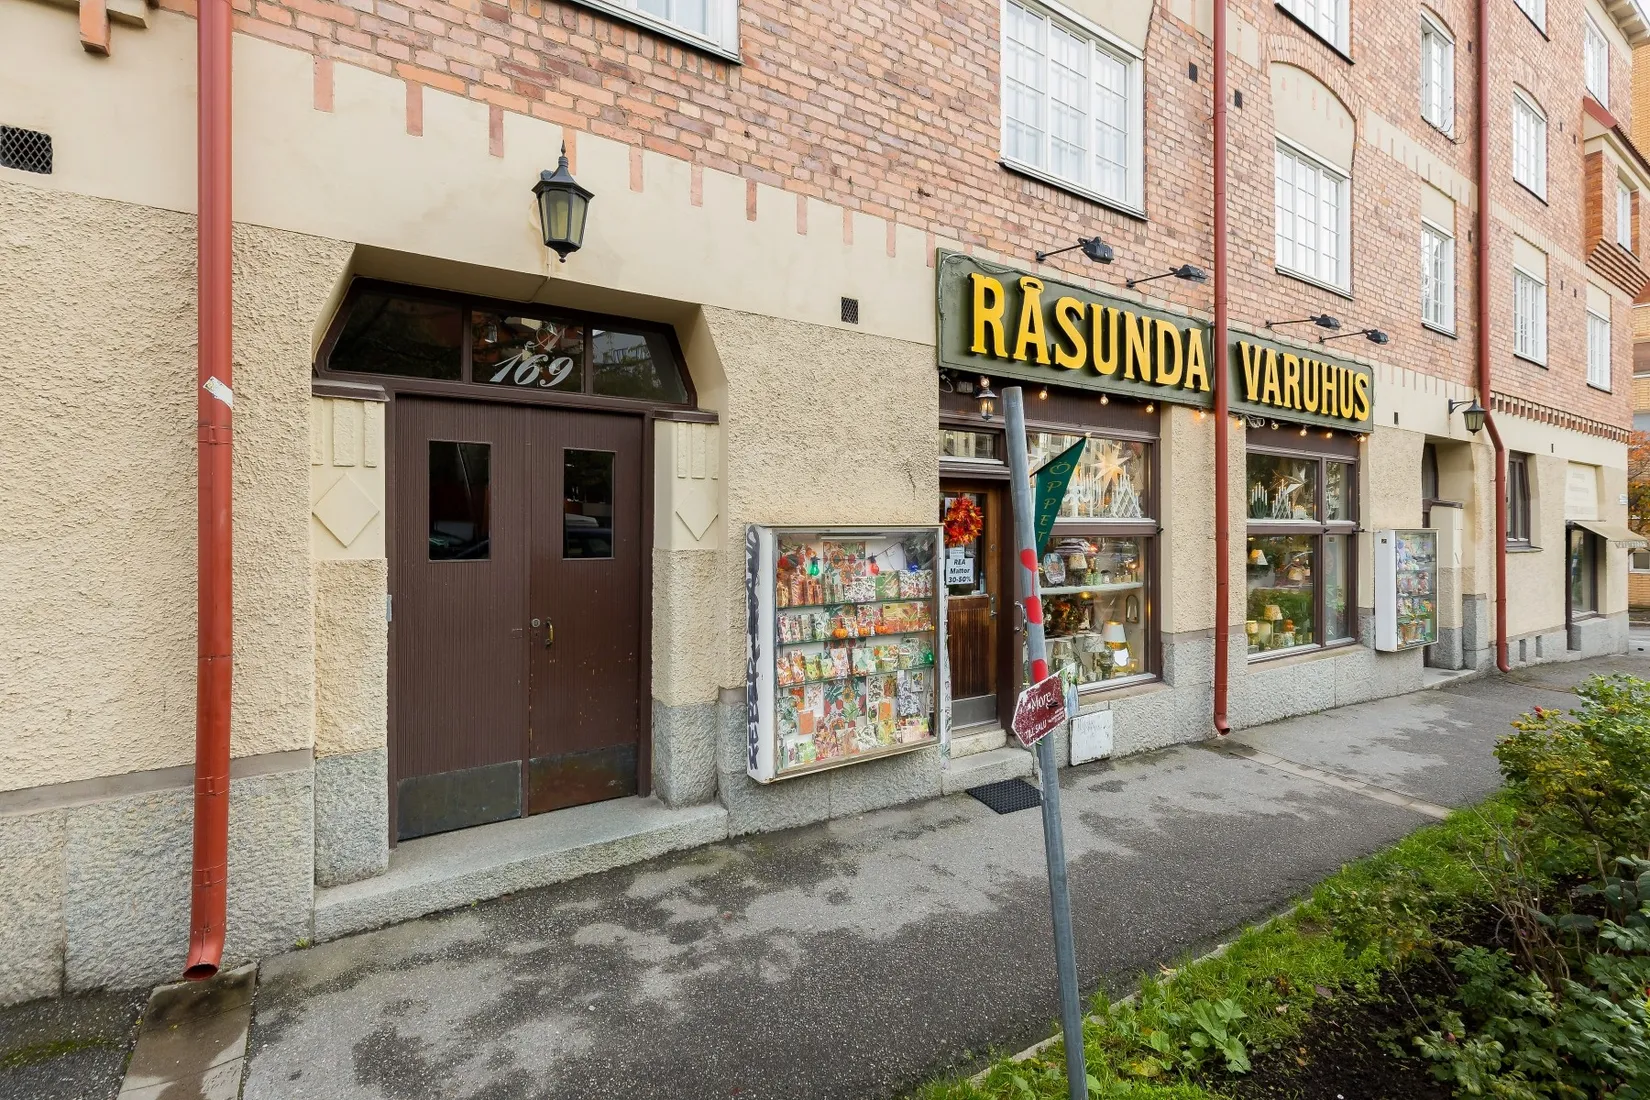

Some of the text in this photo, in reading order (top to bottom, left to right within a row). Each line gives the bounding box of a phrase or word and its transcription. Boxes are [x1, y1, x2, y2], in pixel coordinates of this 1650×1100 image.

[489, 353, 574, 387] 169
[969, 273, 1370, 422] RÅSUNDA VARUHUS
[1038, 462, 1071, 543] ÖPPET
[953, 558, 966, 566] REA
